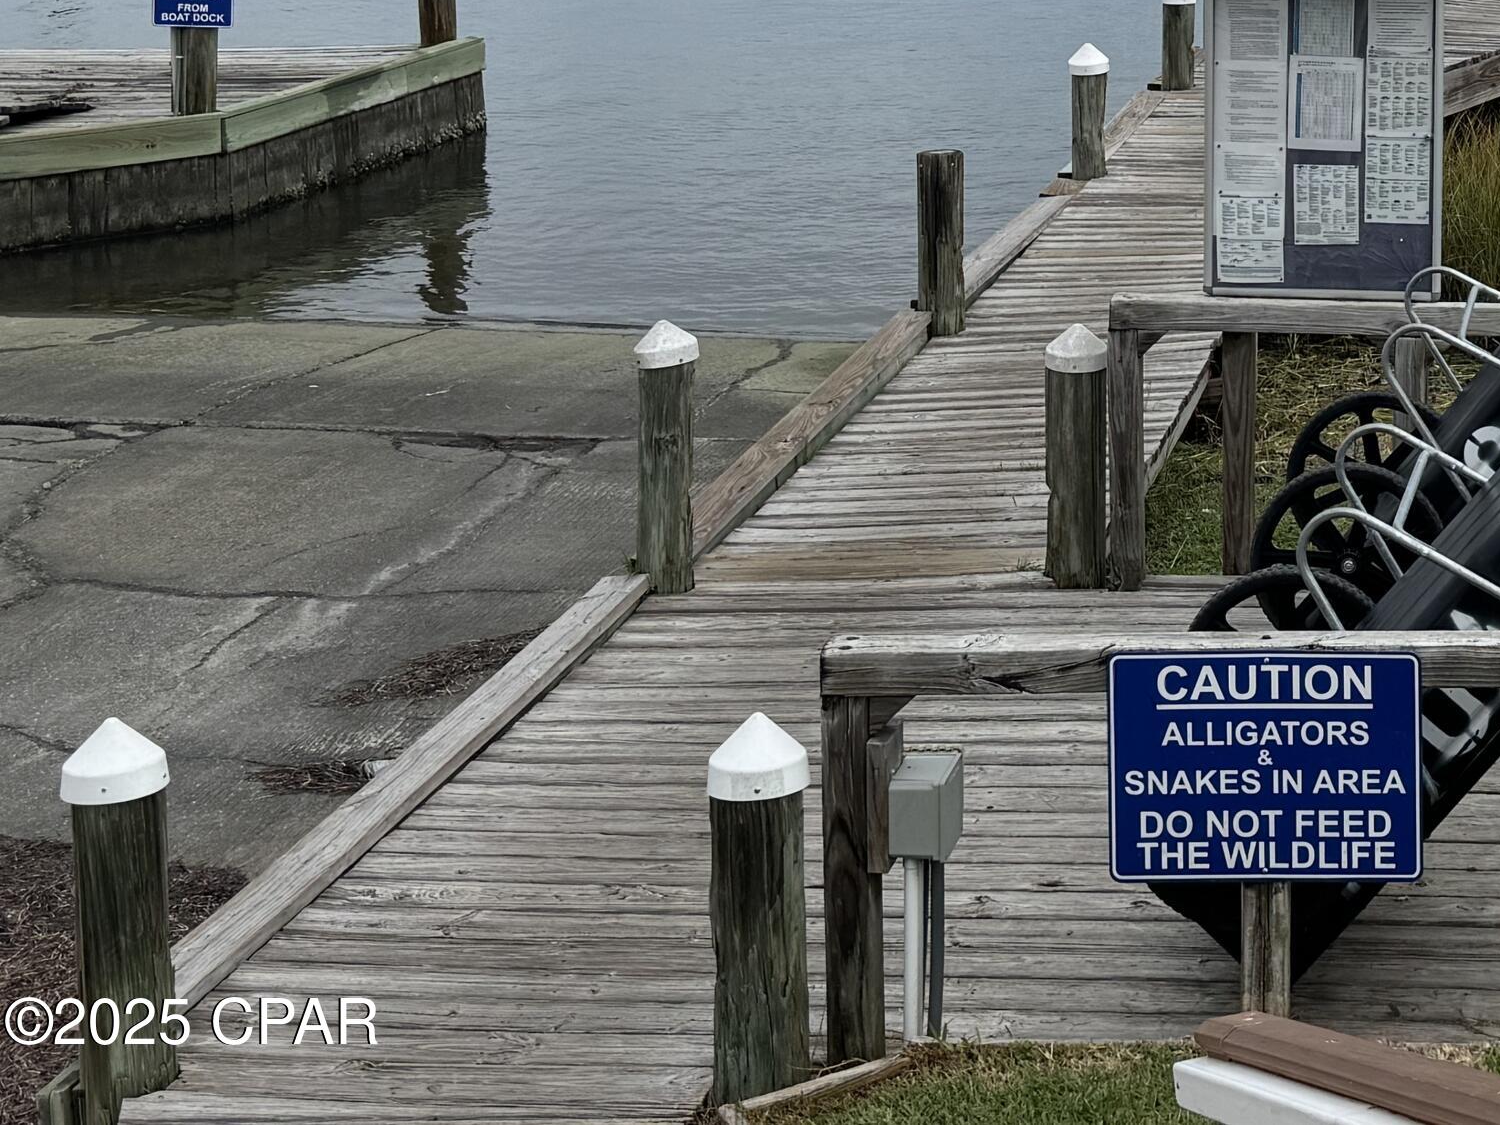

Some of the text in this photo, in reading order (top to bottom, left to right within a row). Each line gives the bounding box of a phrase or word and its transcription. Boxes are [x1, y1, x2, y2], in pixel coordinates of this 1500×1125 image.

[161, 13, 225, 23] BOAT DOCK
[177, 3, 209, 13] FROM
[1156, 665, 1373, 701] CAUTION
[1161, 721, 1370, 746] ALLIGATORS
[1257, 749, 1274, 766] &
[1124, 769, 1406, 795] SNAKES IN AREA
[1140, 810, 1392, 838] DO NOT FEED
[1136, 841, 1396, 870] THE WILDLIFE
